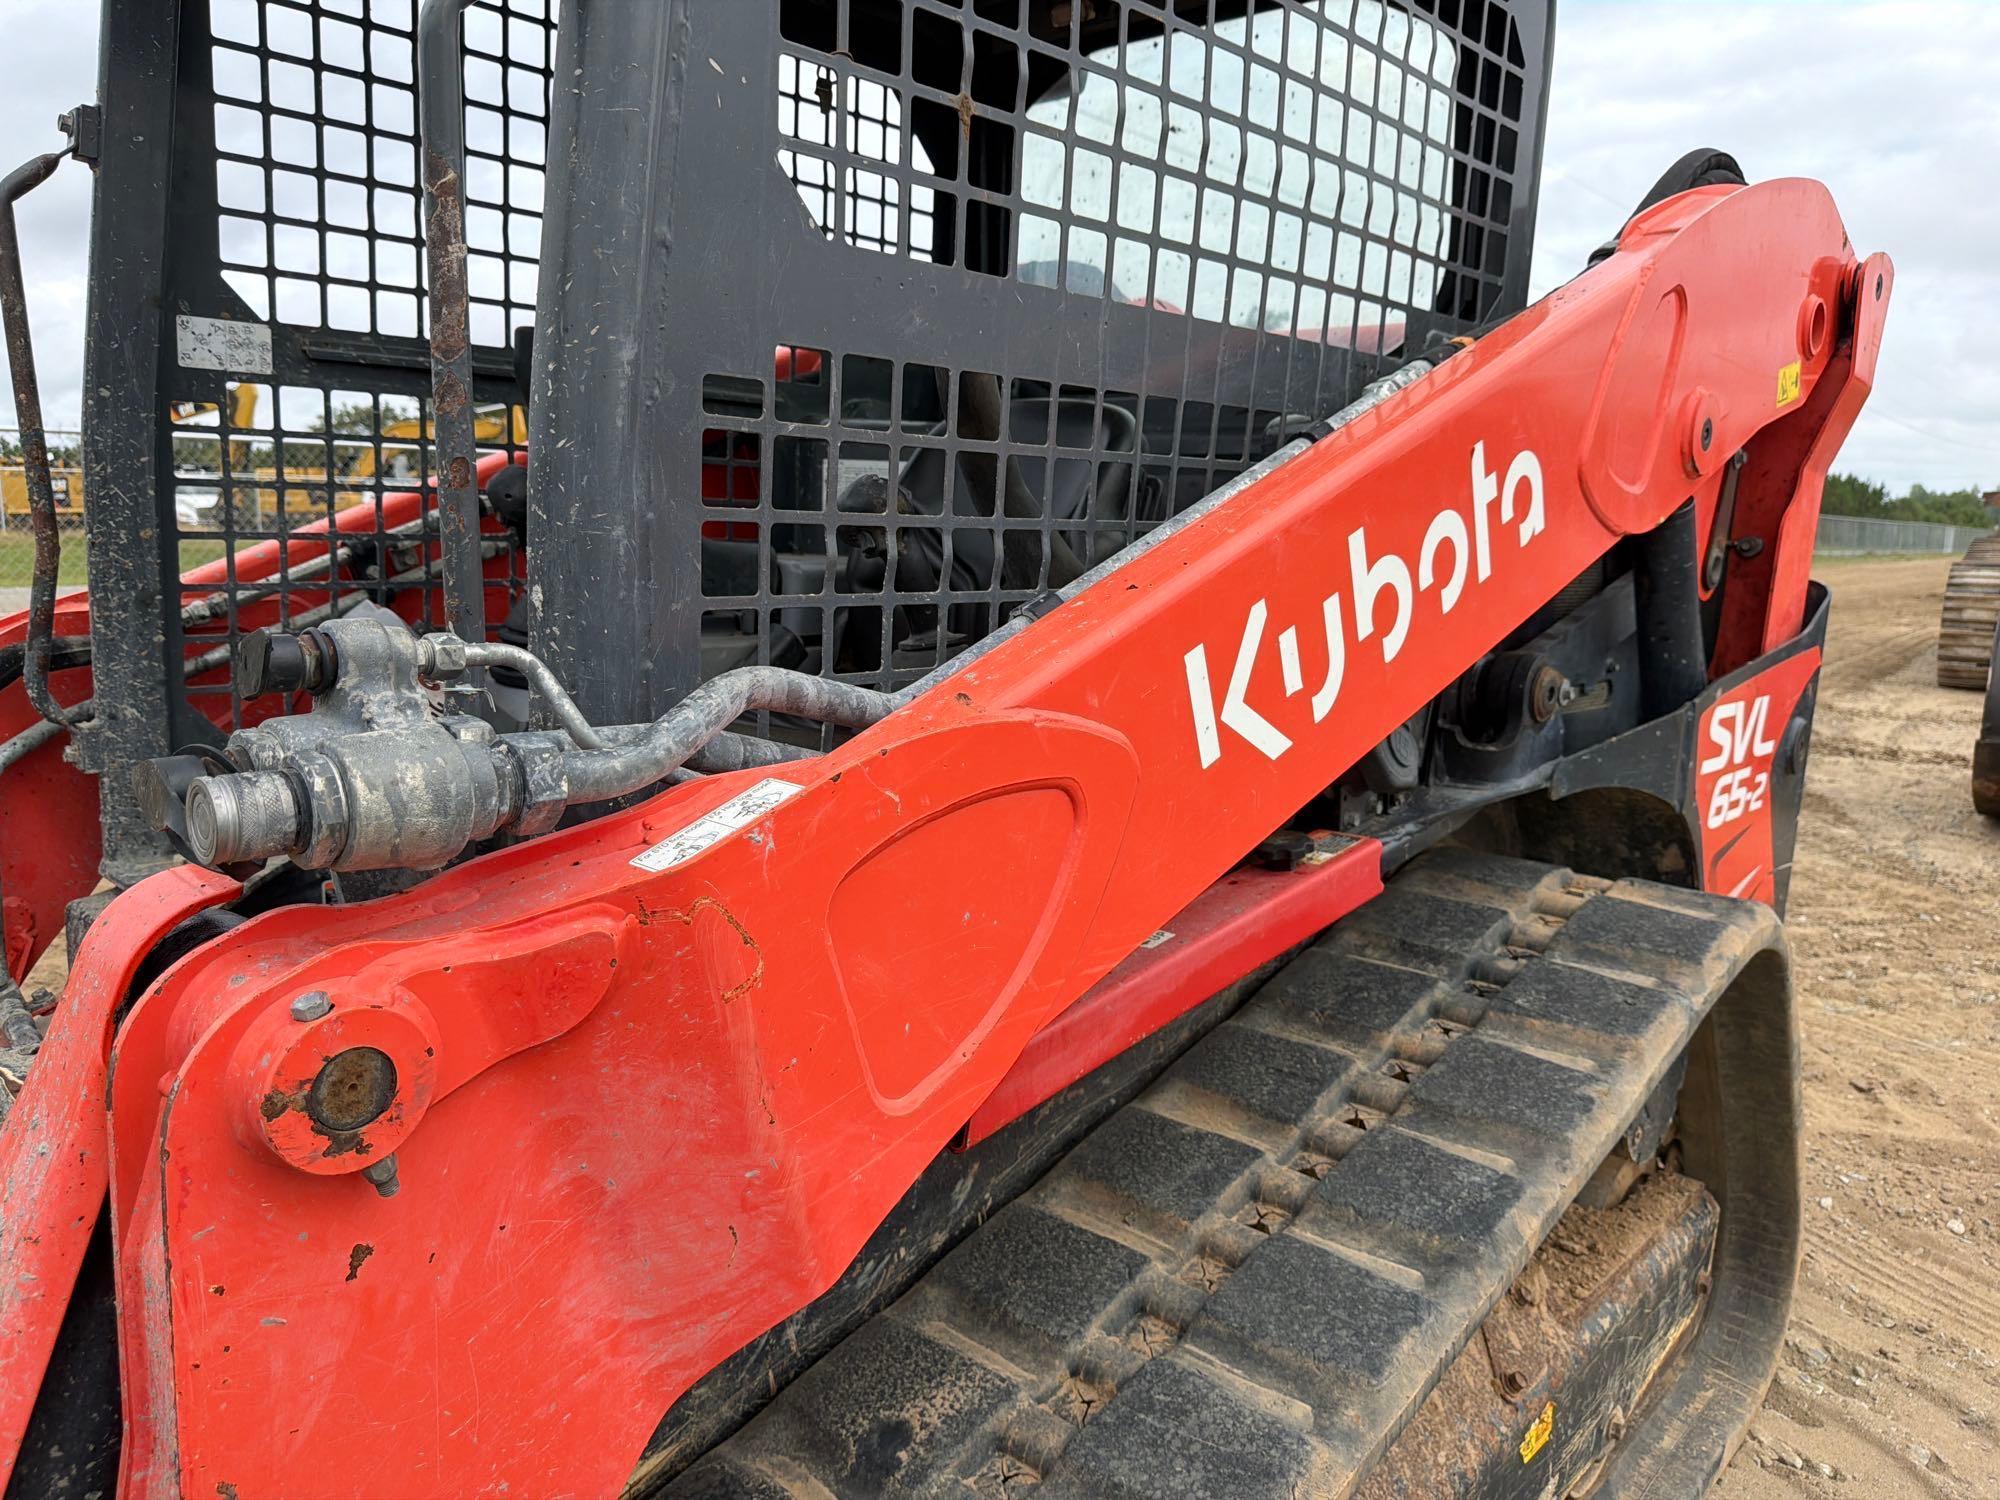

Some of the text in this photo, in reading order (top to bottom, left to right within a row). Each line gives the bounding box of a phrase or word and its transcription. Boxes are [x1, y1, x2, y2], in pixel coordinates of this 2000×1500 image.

[1184, 440, 1545, 770] Kubota
[1700, 695, 1775, 775] SVL
[1707, 766, 1768, 829] 65-2
